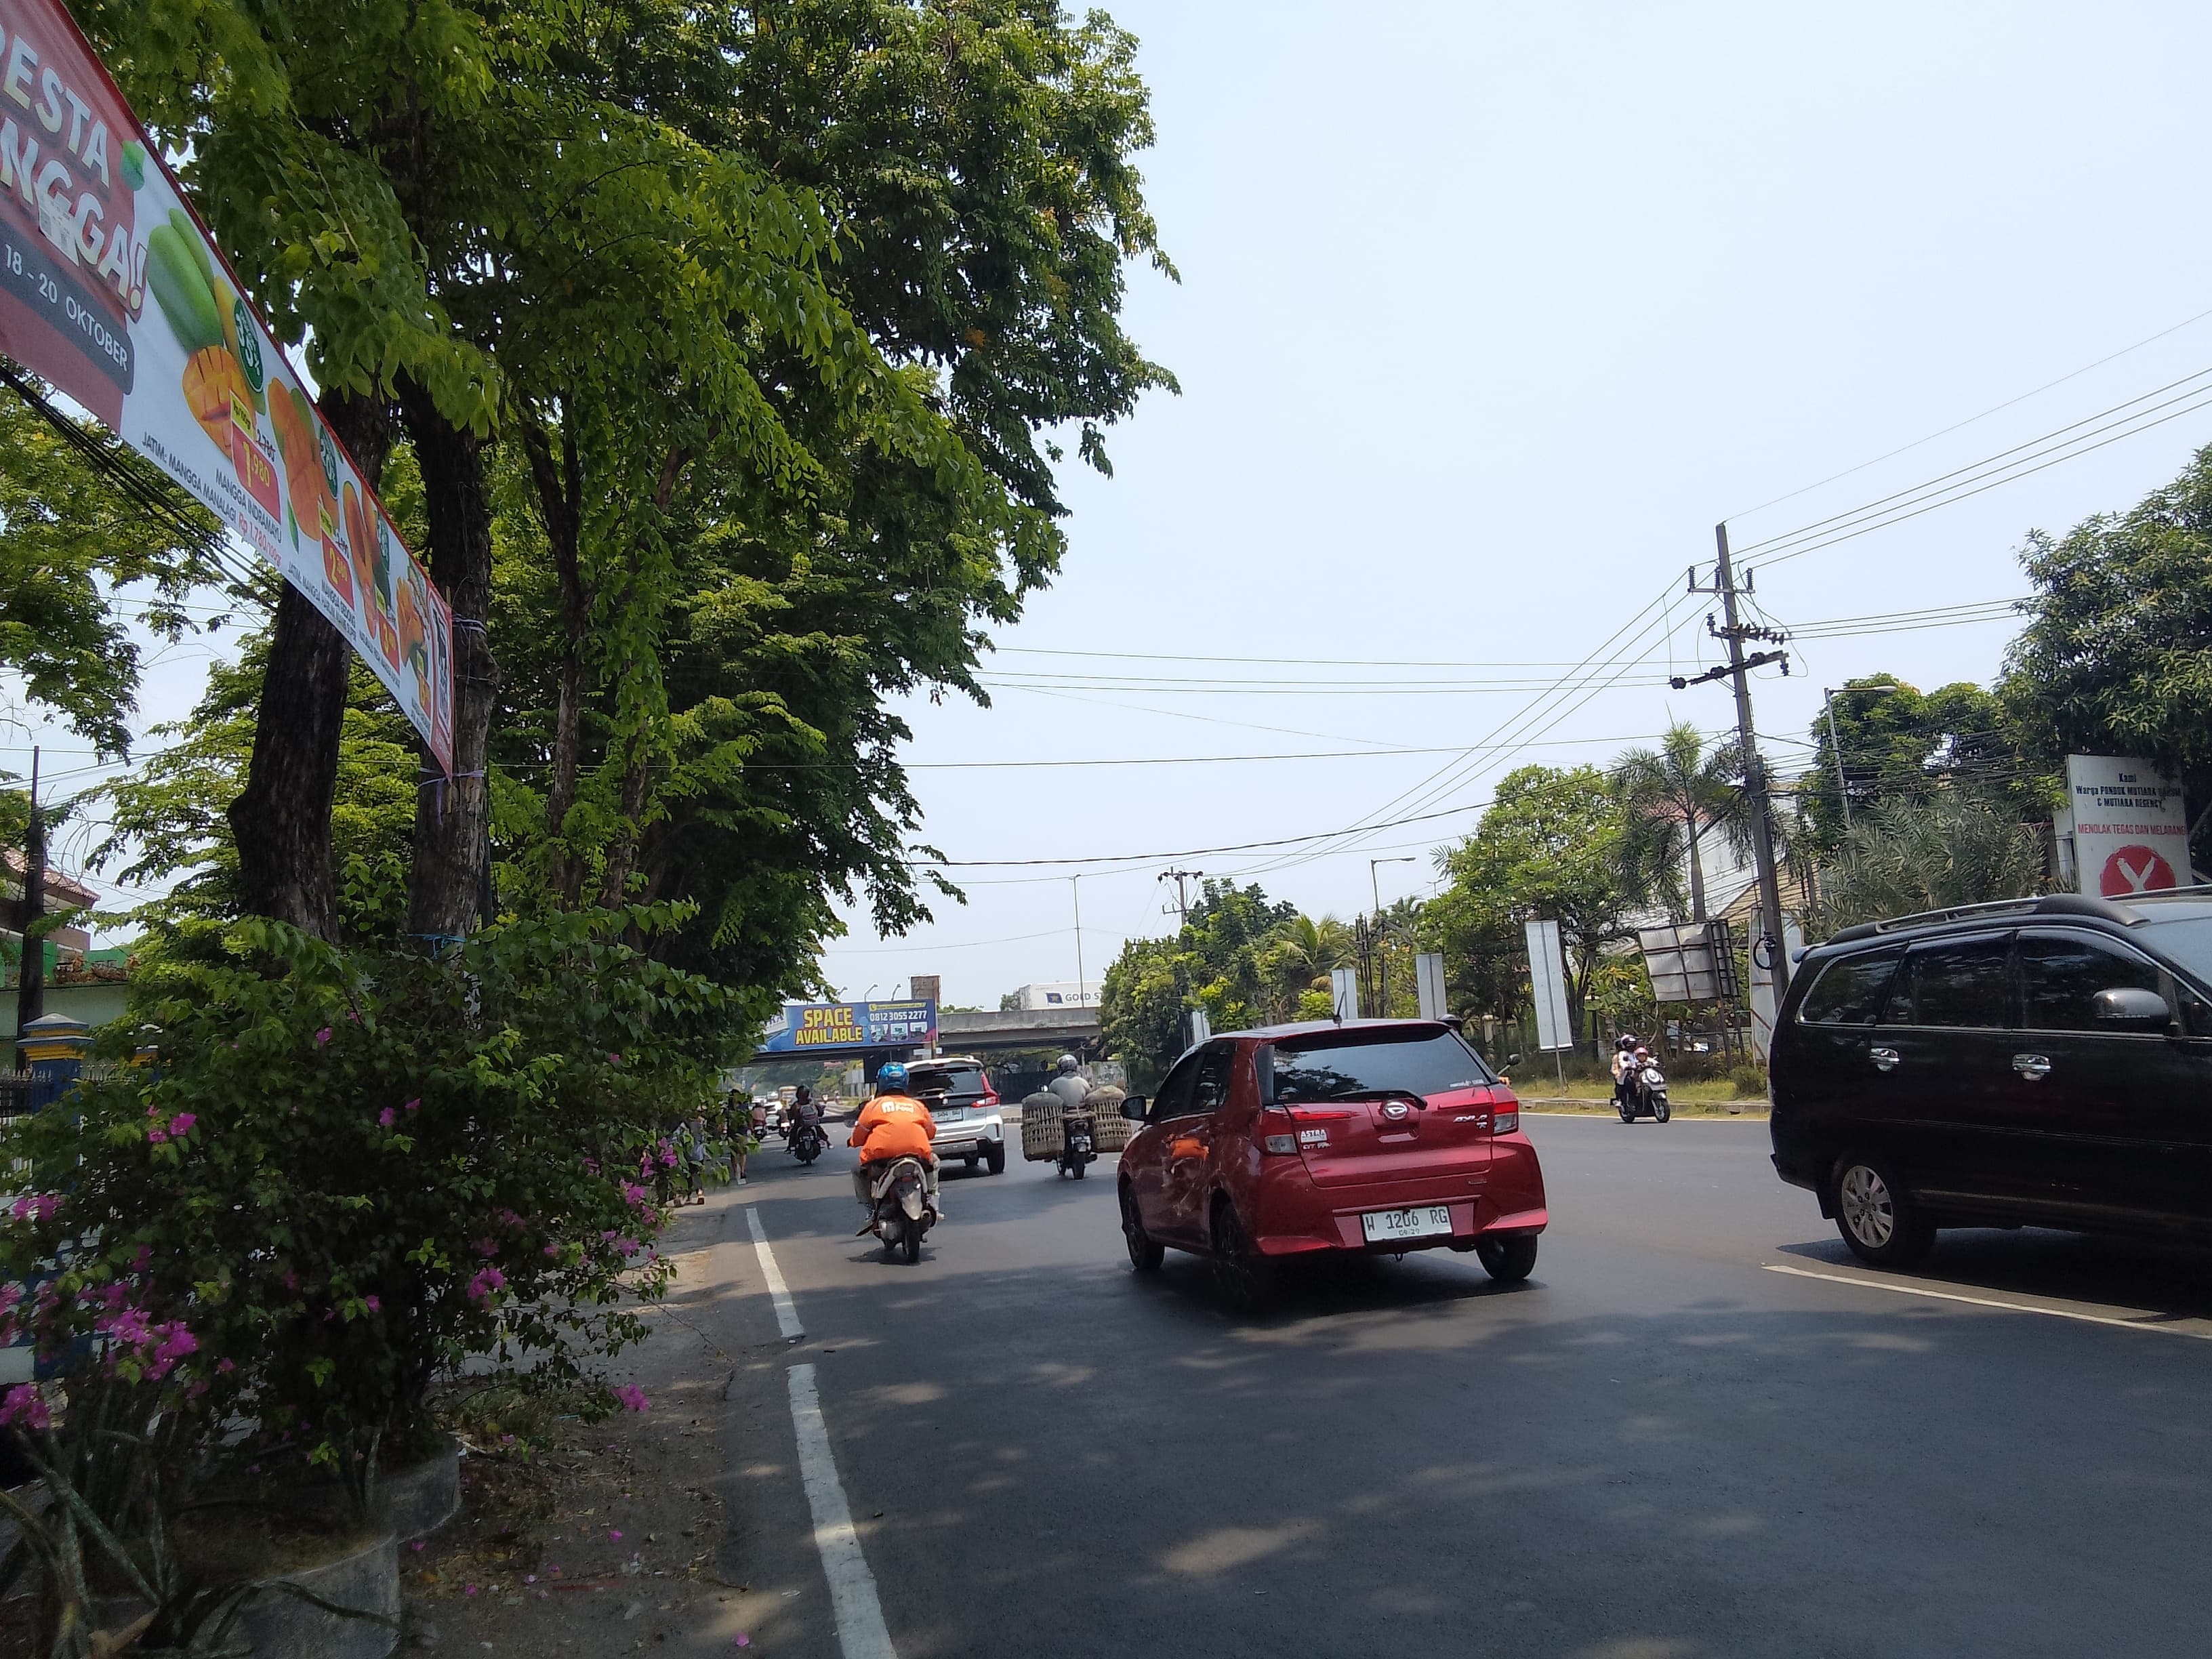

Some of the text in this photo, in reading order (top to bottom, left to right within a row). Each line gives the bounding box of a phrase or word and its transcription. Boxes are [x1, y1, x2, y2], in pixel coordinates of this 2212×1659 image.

[5, 244, 22, 275] 18
[39, 272, 58, 304] 20
[66, 296, 127, 372] OKTOBER
[142, 432, 167, 464] JATIM:
[169, 453, 202, 495] MANGGA
[203, 483, 237, 524] MANALAGI
[239, 512, 248, 535] Rp
[216, 469, 247, 510] MANGGA
[248, 502, 282, 544] INDRAMAYU
[2118, 773, 2137, 783] Kami
[2075, 785, 2099, 796] Warga
[2100, 786, 2126, 795] PONDOK
[2127, 787, 2156, 796] MUTIARA
[2104, 798, 2133, 807] MUTIARA
[2078, 824, 2110, 834] MENOLAK
[2112, 824, 2134, 835] TEGAS
[2135, 825, 2149, 835] DAN
[1065, 993, 1091, 1002] GOD
[804, 1007, 853, 1028] SPACE
[869, 1010, 927, 1021] 0812 3055 2277
[796, 1027, 863, 1045] AVAILABLE
[1301, 1128, 1326, 1138] ASTRA
[1386, 1211, 1419, 1229] 1206
[1429, 1208, 1448, 1225] RG
